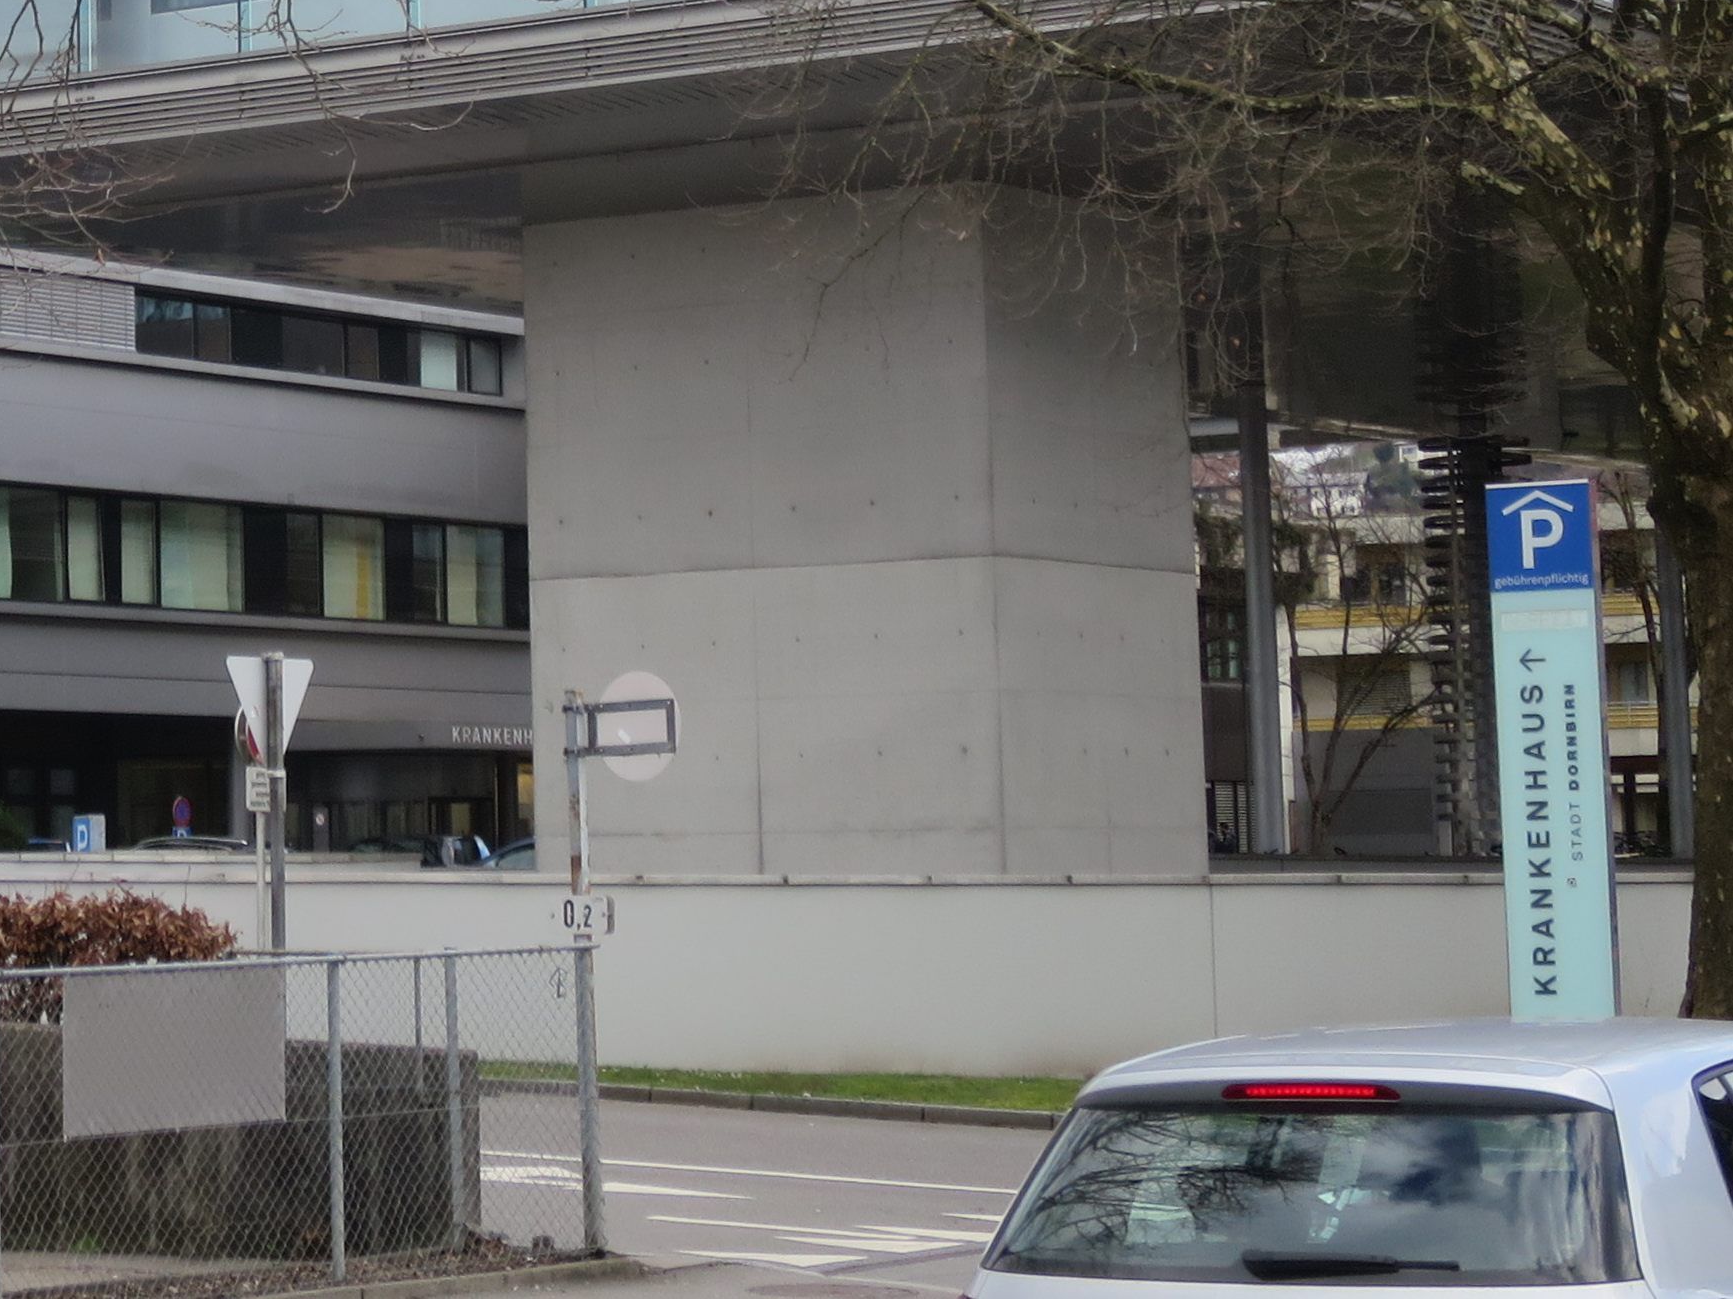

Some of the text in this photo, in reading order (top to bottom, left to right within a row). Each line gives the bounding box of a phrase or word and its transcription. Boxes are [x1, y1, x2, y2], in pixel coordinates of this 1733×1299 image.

[1520, 509, 1564, 569] P
[1494, 573, 1589, 590] gebührenpflichtig
[1563, 683, 1584, 862] STADT DORNBIRN
[1520, 683, 1558, 996] KRANKENHAUS
[563, 899, 593, 931] 0,2
